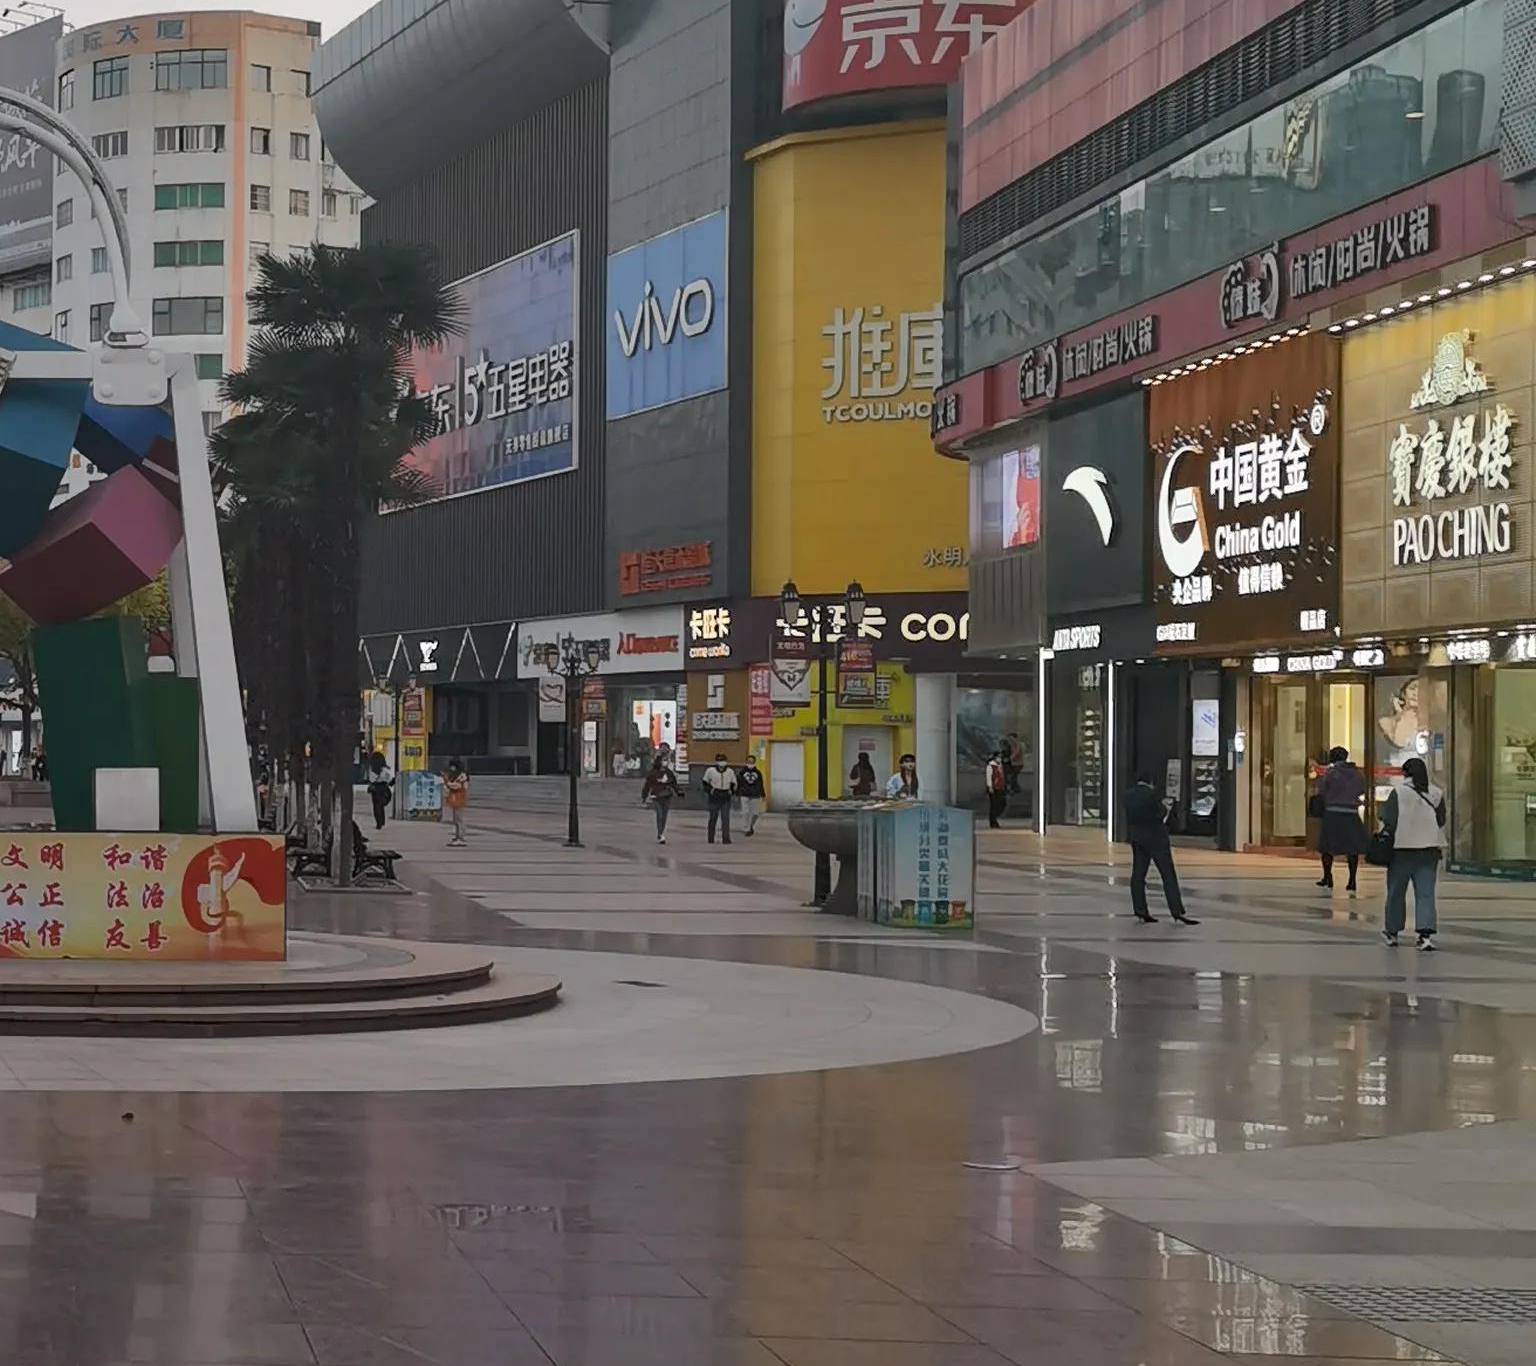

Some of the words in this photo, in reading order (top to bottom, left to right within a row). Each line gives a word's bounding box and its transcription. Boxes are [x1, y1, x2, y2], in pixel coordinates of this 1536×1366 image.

[1289, 206, 1430, 299] 休闲/时尚/火锅
[614, 278, 713, 357] vivo
[487, 341, 570, 419] 五星电器
[1209, 427, 1313, 511] 中国黄金
[1214, 522, 1259, 560] China
[1261, 510, 1301, 552] Gold
[0, 843, 65, 871] 文明
[103, 843, 168, 872] 和谐
[0, 882, 65, 908] 公正
[106, 881, 165, 909] 法治
[0, 920, 65, 948] 诚信
[105, 919, 168, 950] 友善
